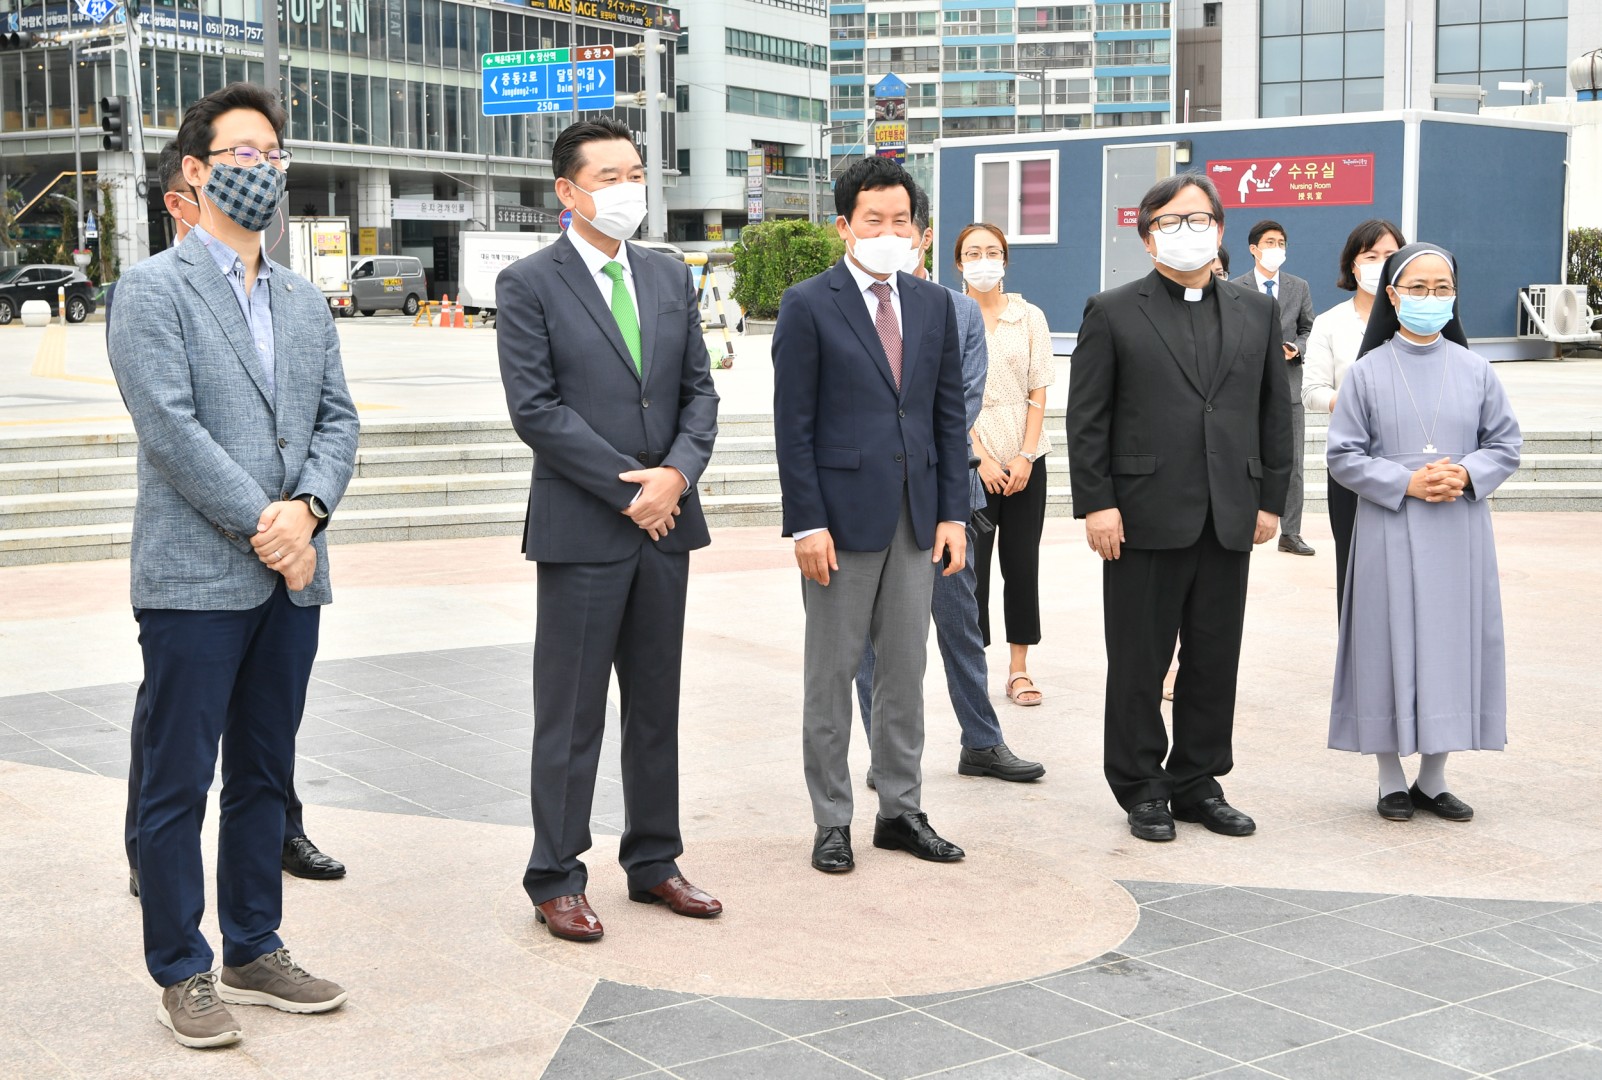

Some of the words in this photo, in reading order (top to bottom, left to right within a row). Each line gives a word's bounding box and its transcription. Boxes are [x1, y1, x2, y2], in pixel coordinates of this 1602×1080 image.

[91, 1, 107, 16] 214
[291, 0, 365, 34] OPEN
[644, 17, 653, 28] 3F
[146, 31, 223, 55] SCHEDULE
[536, 51, 557, 62] 장산역
[583, 48, 601, 59] 송정
[1287, 161, 1335, 180] 수유실
[1290, 183, 1312, 191] Nursing
[498, 211, 544, 223] SCHEDULE
